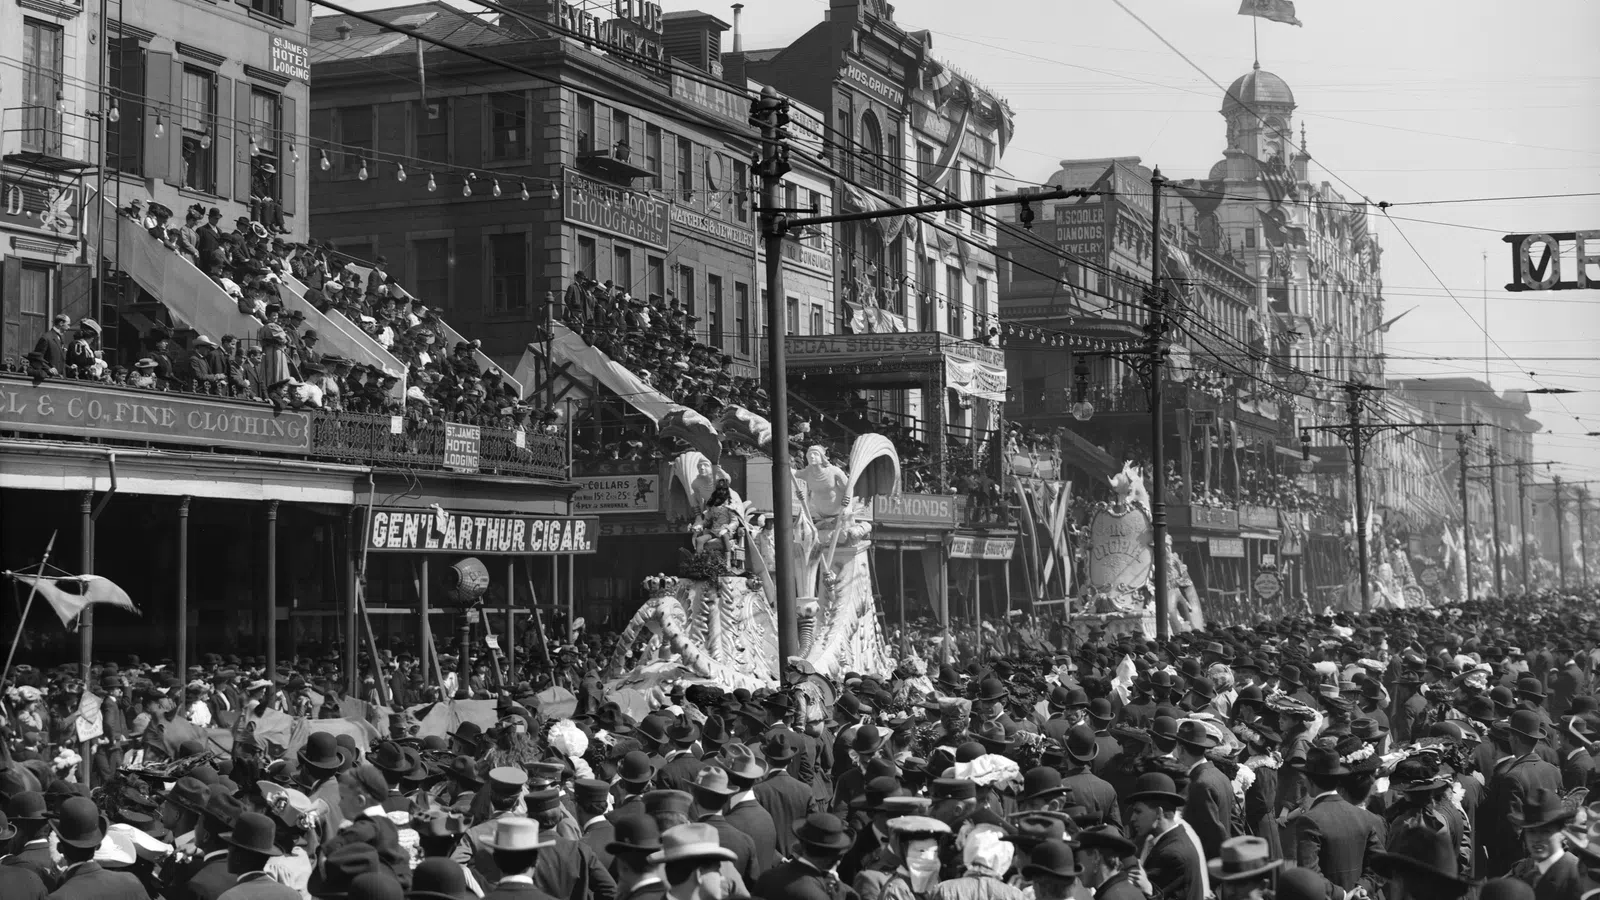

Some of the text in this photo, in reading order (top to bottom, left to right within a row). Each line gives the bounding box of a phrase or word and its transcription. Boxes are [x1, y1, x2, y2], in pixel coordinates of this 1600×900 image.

[272, 47, 310, 69] HOTEL
[283, 40, 308, 57] JAMES
[273, 58, 309, 80] LODGING
[671, 209, 755, 247] WATCHES & JEWELRY
[785, 338, 842, 355] REGAL
[847, 336, 895, 353] SHOE
[37, 394, 55, 416] &
[114, 402, 176, 429] FINE
[187, 409, 301, 439] CLOTHING
[457, 428, 480, 440] JAMES
[446, 440, 478, 454] HOTEL
[445, 453, 478, 467] LODGING
[588, 480, 630, 490] COLLARS
[371, 511, 591, 552] GEN'L ARTHUR CIGAR.
